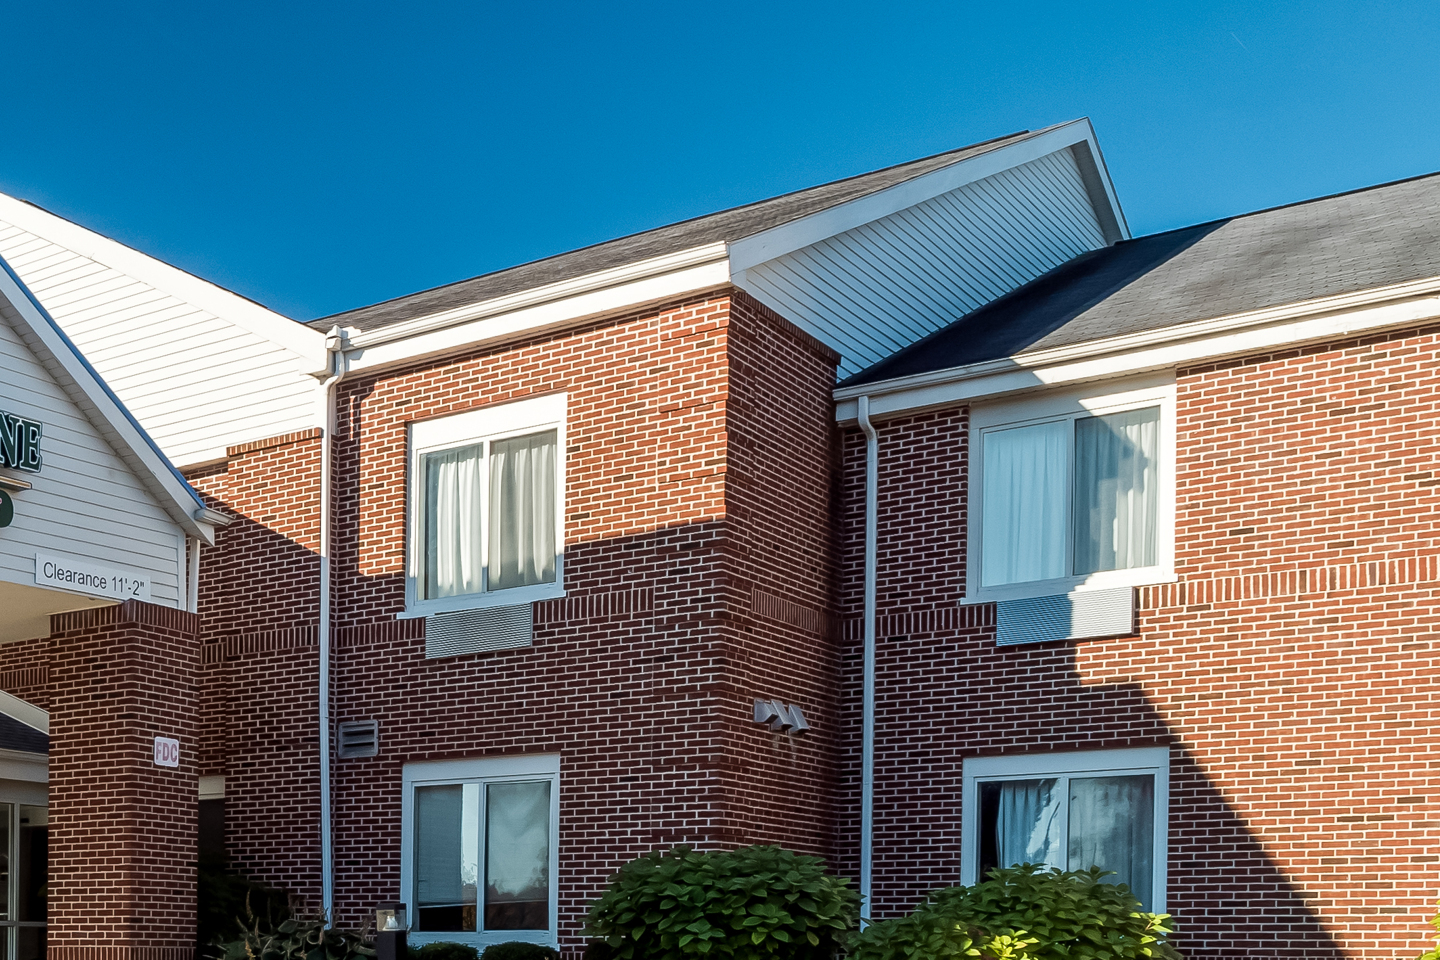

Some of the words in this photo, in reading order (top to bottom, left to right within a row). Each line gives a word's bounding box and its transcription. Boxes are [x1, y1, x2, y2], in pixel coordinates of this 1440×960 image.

[43, 561, 107, 590] Clearance
[111, 575, 145, 597] 11'-2"
[155, 741, 178, 763] FDC
